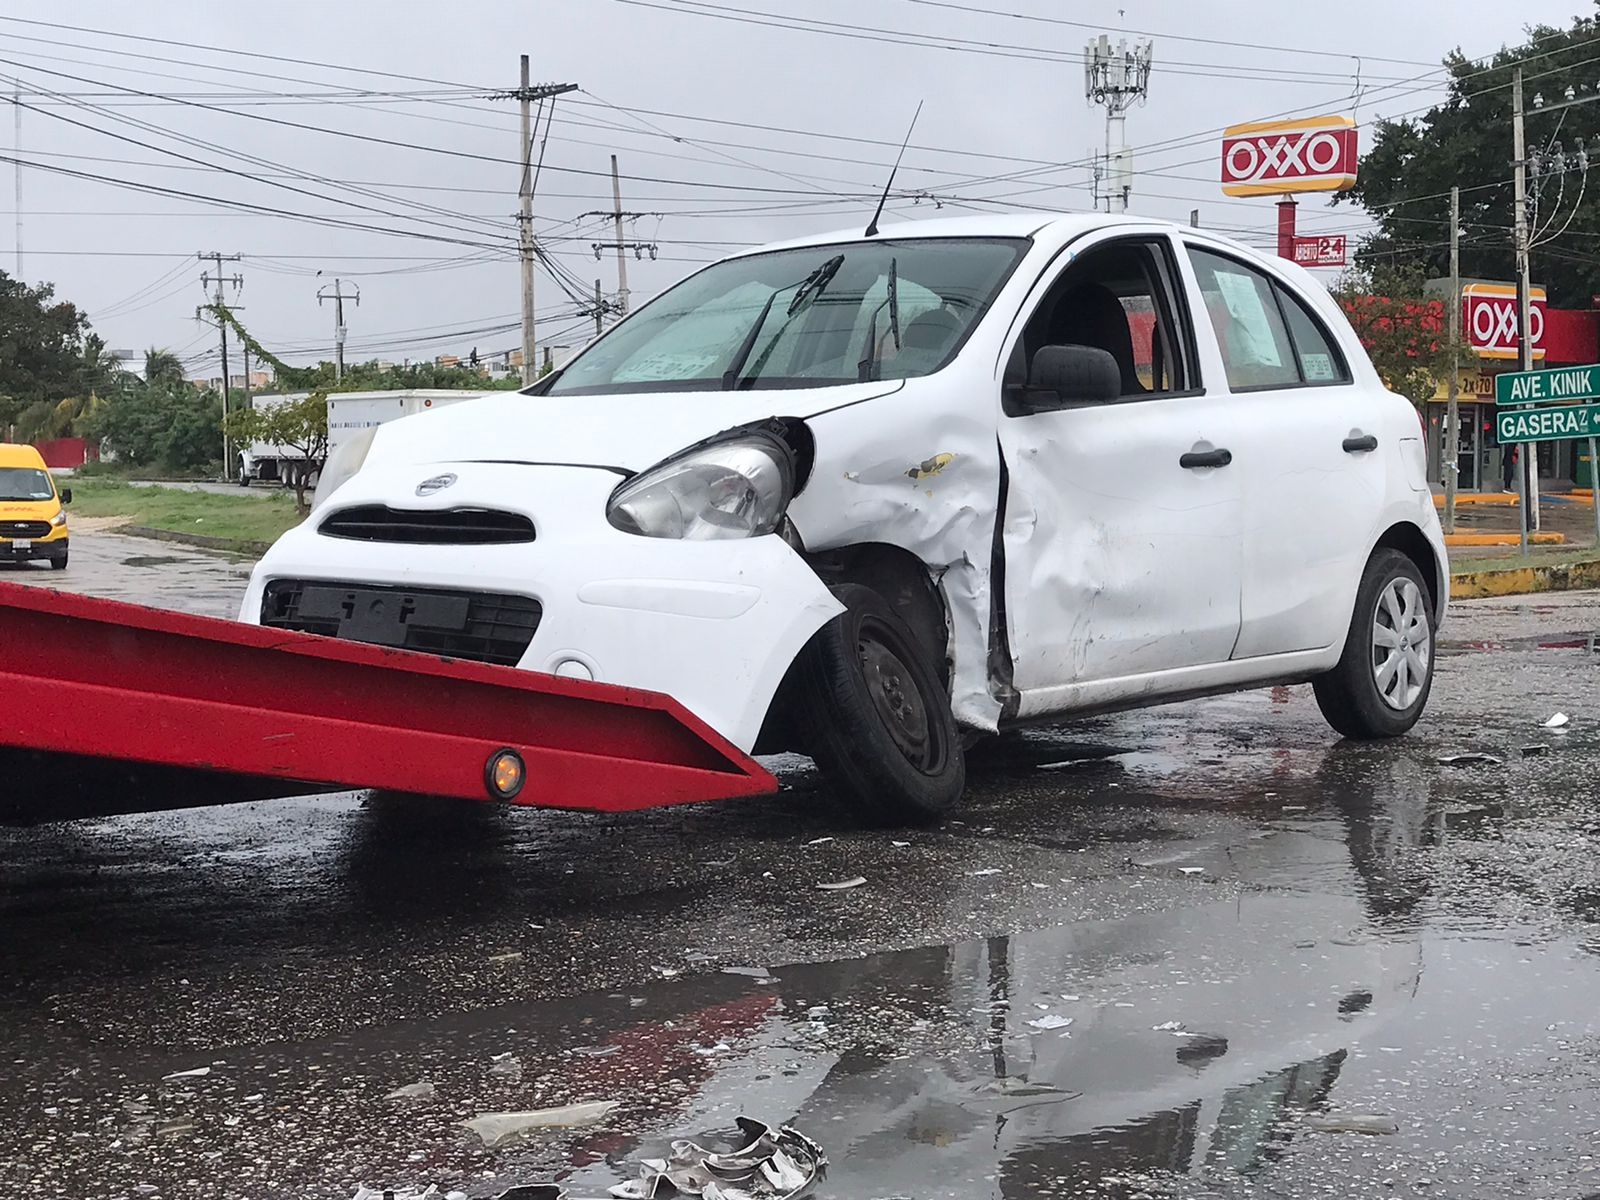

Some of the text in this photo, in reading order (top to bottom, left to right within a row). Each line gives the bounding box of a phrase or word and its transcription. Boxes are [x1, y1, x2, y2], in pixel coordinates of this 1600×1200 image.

[1226, 133, 1340, 181] OXXO
[1319, 238, 1342, 255] 24
[1511, 370, 1592, 400] AVE. KINIK
